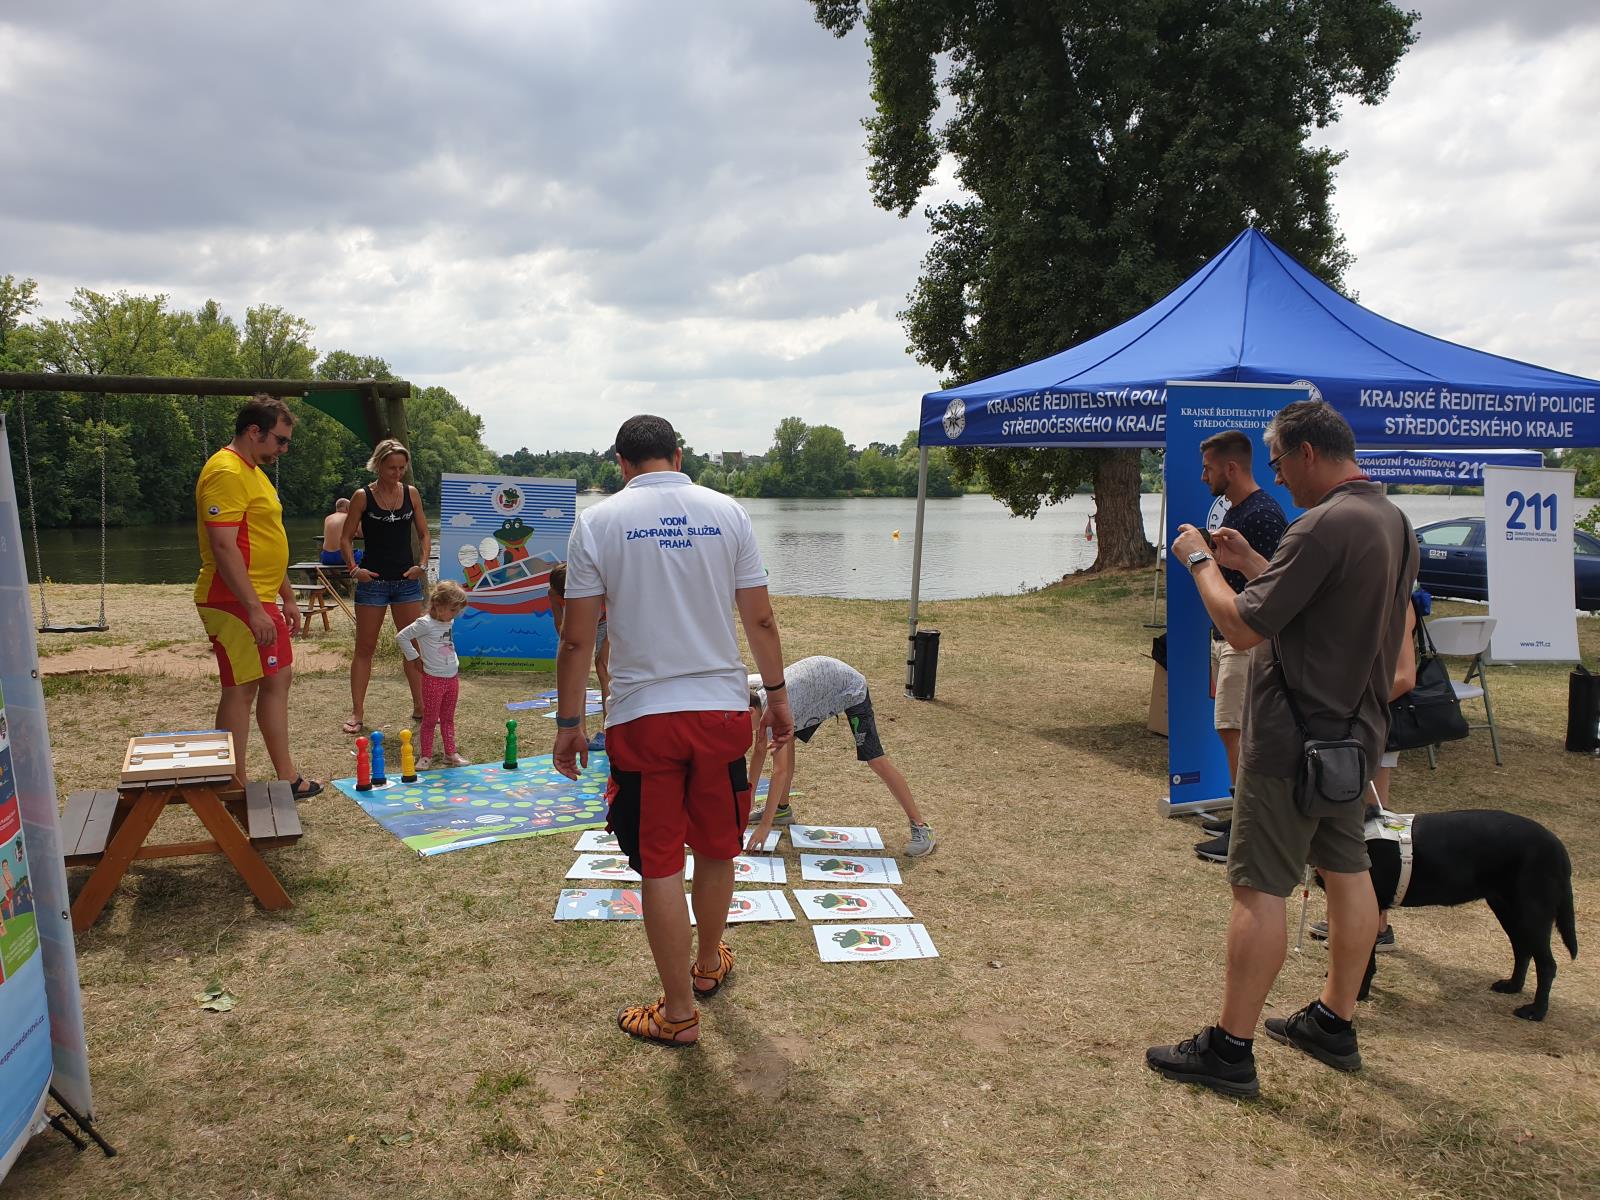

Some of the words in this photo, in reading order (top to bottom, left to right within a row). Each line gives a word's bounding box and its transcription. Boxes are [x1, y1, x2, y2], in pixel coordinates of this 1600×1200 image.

[987, 392, 1040, 414] KRAJSKÉ
[1043, 388, 1129, 411] ŘEDITELSTVÍ
[1131, 389, 1167, 406] POLI
[1359, 388, 1436, 409] KRAJSKÉ
[1440, 388, 1536, 412] ŘEDITELSTVÍ
[1540, 396, 1596, 414] POLICIE
[1180, 407, 1215, 417] KRAJSKÉ
[1216, 407, 1266, 418] ŘEDITELSTVÍ
[1002, 414, 1112, 436] STŘEDOČESKÉHO
[1116, 414, 1167, 433] KRAJE
[1193, 419, 1260, 429] STŘEDOČESKÉHO
[1385, 414, 1523, 437] STŘEDOČESKÉHO
[1526, 421, 1574, 438] KRAJE
[1403, 456, 1456, 468] POJIŠŤOVNA
[1361, 468, 1411, 477] INISTERSTVA
[1413, 469, 1443, 478] VNITRA
[1444, 468, 1456, 478] ČR
[1458, 461, 1487, 479] 211
[1505, 491, 1557, 531] 211
[659, 515, 687, 526] VODNÍ
[626, 527, 683, 540] ZÁCHRANNÁ
[687, 525, 721, 536] SLUŽBA
[659, 539, 692, 549] PRAHA
